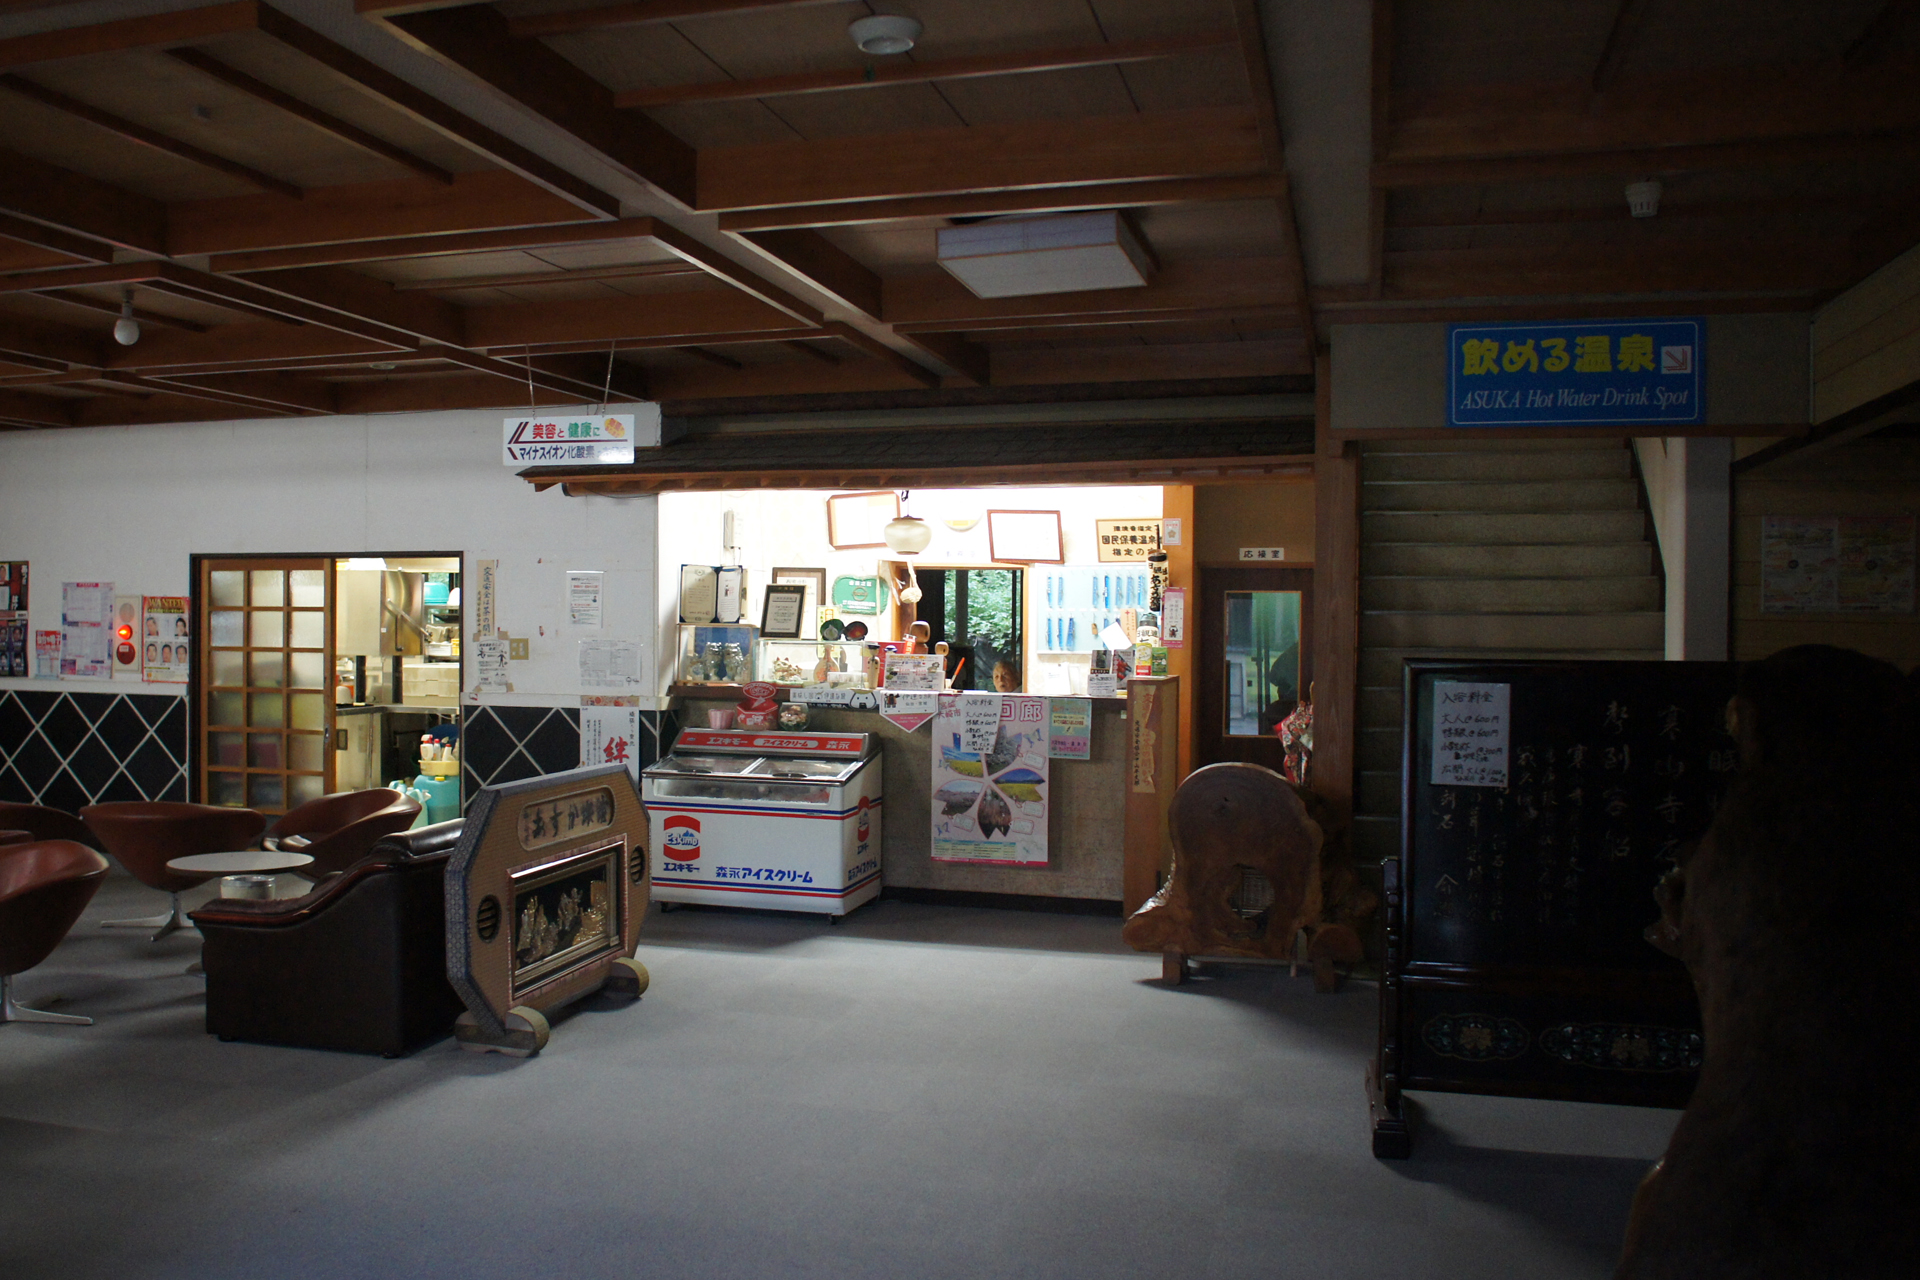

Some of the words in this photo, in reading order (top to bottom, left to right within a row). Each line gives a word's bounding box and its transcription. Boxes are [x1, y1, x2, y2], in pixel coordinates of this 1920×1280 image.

[1461, 333, 1656, 376] 飲める温泉
[1461, 390, 1522, 409] ASUKA
[1525, 389, 1556, 408] Hot
[1557, 388, 1600, 407] Water
[1602, 386, 1650, 406] Drink
[1653, 386, 1689, 410] Spot
[532, 422, 600, 440] 美容と健康に
[1243, 549, 1280, 559] 応接室
[1442, 690, 1493, 704] 入浴料金
[1000, 700, 1042, 722] 回廊
[603, 736, 629, 763] 絆
[706, 736, 748, 745] エスキモー
[763, 739, 808, 747] アイスクリーム
[825, 740, 851, 749] 森永
[665, 832, 699, 846] Eskimo
[663, 862, 700, 873] エスキモー
[716, 866, 813, 883] 森永アイスクリーム
